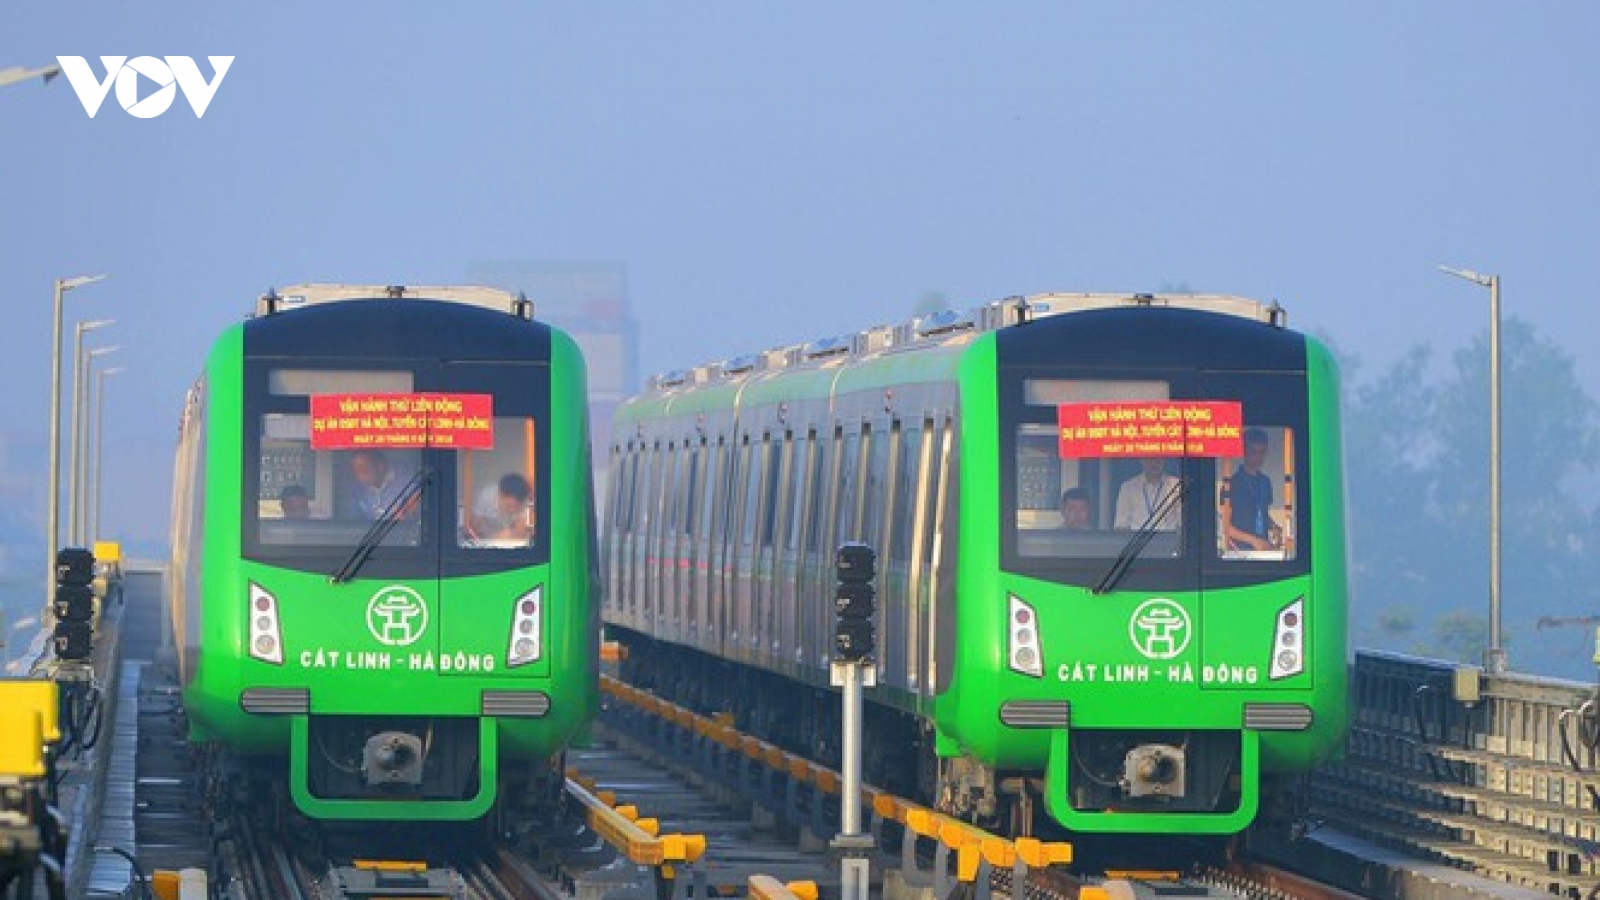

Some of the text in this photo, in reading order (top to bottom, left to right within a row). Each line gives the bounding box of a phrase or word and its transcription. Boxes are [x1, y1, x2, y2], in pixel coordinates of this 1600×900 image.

[300, 647, 339, 667] CÁT
[346, 651, 391, 669] LINH
[409, 650, 435, 670] HÀ
[1058, 661, 1097, 681] CÁT
[1104, 663, 1149, 682] LINH
[1168, 661, 1194, 682] HÀ
